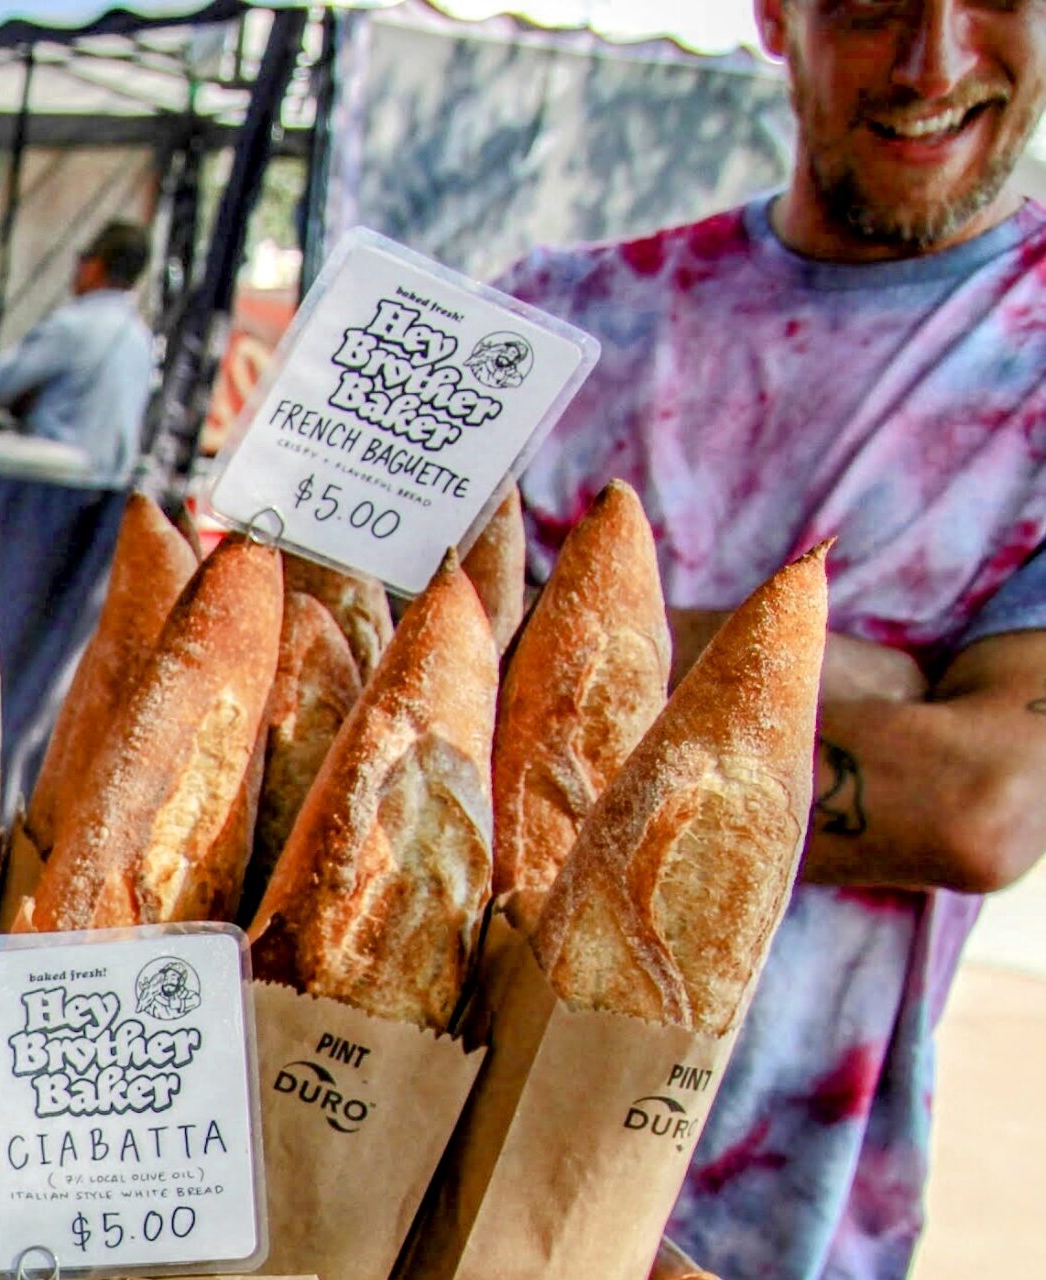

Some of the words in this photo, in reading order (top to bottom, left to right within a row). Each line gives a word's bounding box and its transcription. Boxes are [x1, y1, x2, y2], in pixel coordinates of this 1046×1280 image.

[395, 286, 429, 307] baked
[428, 301, 465, 322] fresh!
[367, 299, 458, 368] Hey
[332, 327, 503, 427] Brother
[328, 368, 463, 452] Baker
[269, 399, 362, 453] FRENCH
[360, 438, 471, 499] BAGUETTE
[277, 438, 317, 458] CRISPY
[397, 487, 433, 508] BREAD
[295, 474, 401, 539] $5.00
[29, 970, 66, 983] baked
[69, 967, 107, 982] fresh!
[21, 987, 120, 1038] Hey
[8, 1019, 202, 1077] Brother
[316, 1032, 371, 1069] PINT
[32, 1065, 180, 1118] Baker
[273, 1070, 368, 1122] DURO
[8, 1120, 227, 1169] CIABATTA
[11, 1191, 68, 1200] ITALIAN
[76, 1191, 112, 1200] STYLE
[121, 1188, 167, 1199] WHITE
[177, 1185, 224, 1196] BREAD
[90, 1174, 126, 1183] LOCAL
[132, 1172, 167, 1181] OLIVE
[72, 1206, 196, 1251] $5.00
